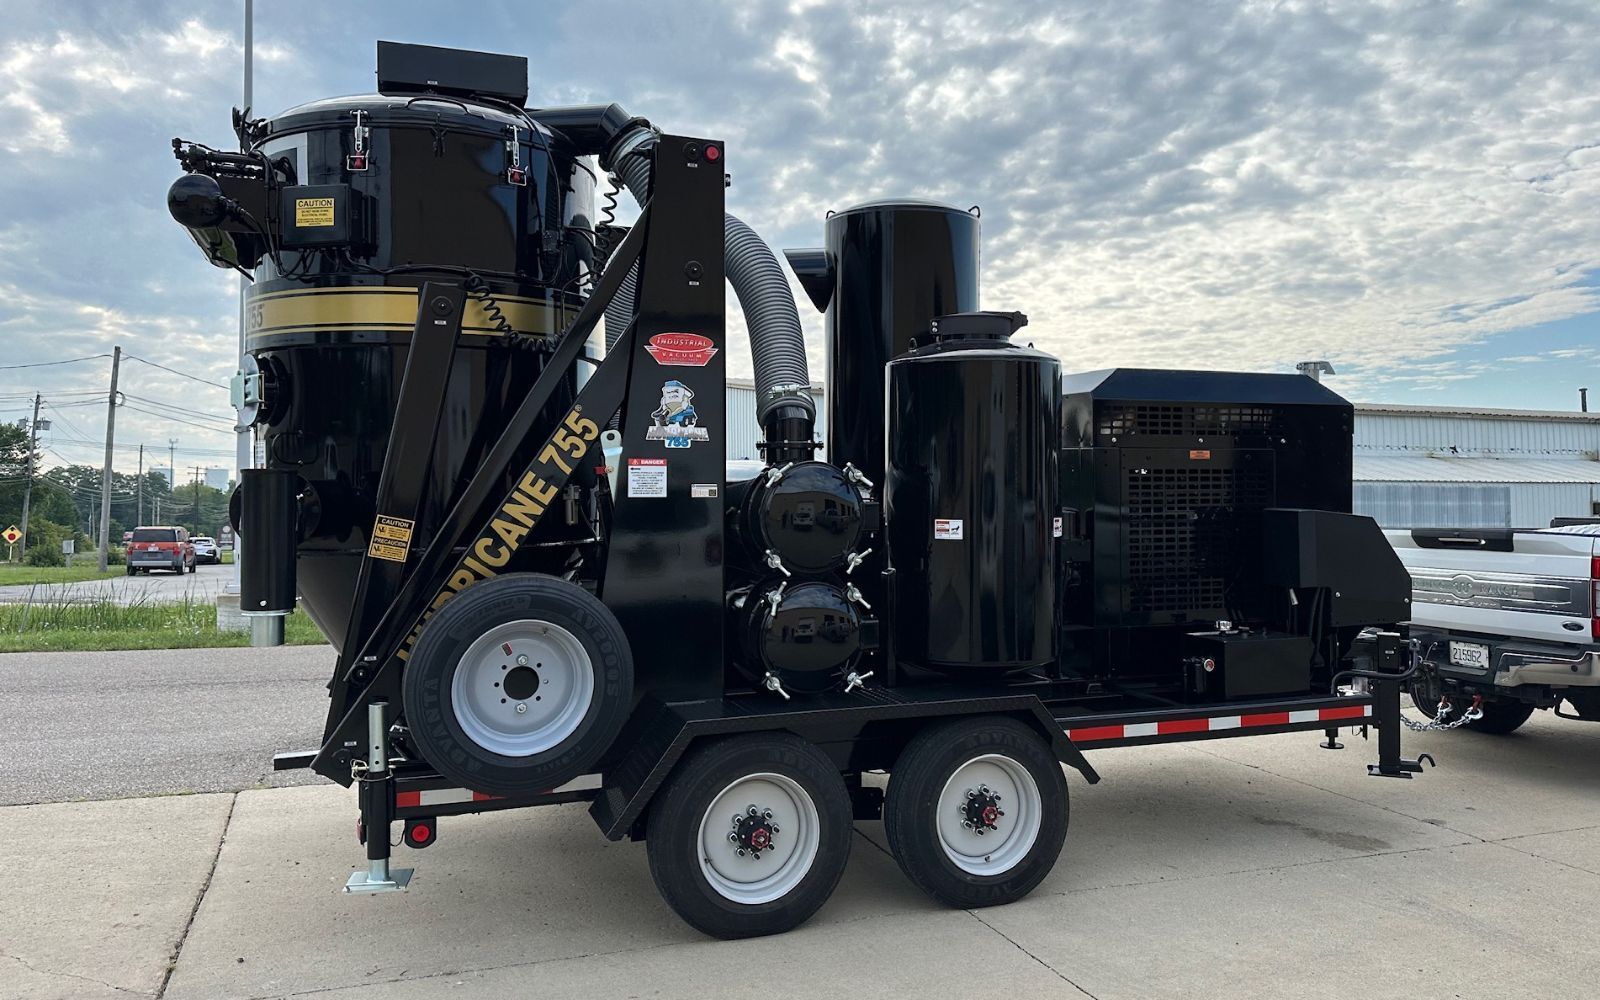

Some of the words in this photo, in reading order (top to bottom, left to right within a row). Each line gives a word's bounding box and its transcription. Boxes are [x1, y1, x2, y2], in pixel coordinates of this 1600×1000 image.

[298, 200, 333, 208] CAUTION
[656, 337, 708, 347] INDUSTRIAL
[381, 518, 409, 528] CAUTION
[396, 471, 559, 661] RICANE
[538, 410, 600, 476] 755
[1452, 647, 1482, 663] 215962
